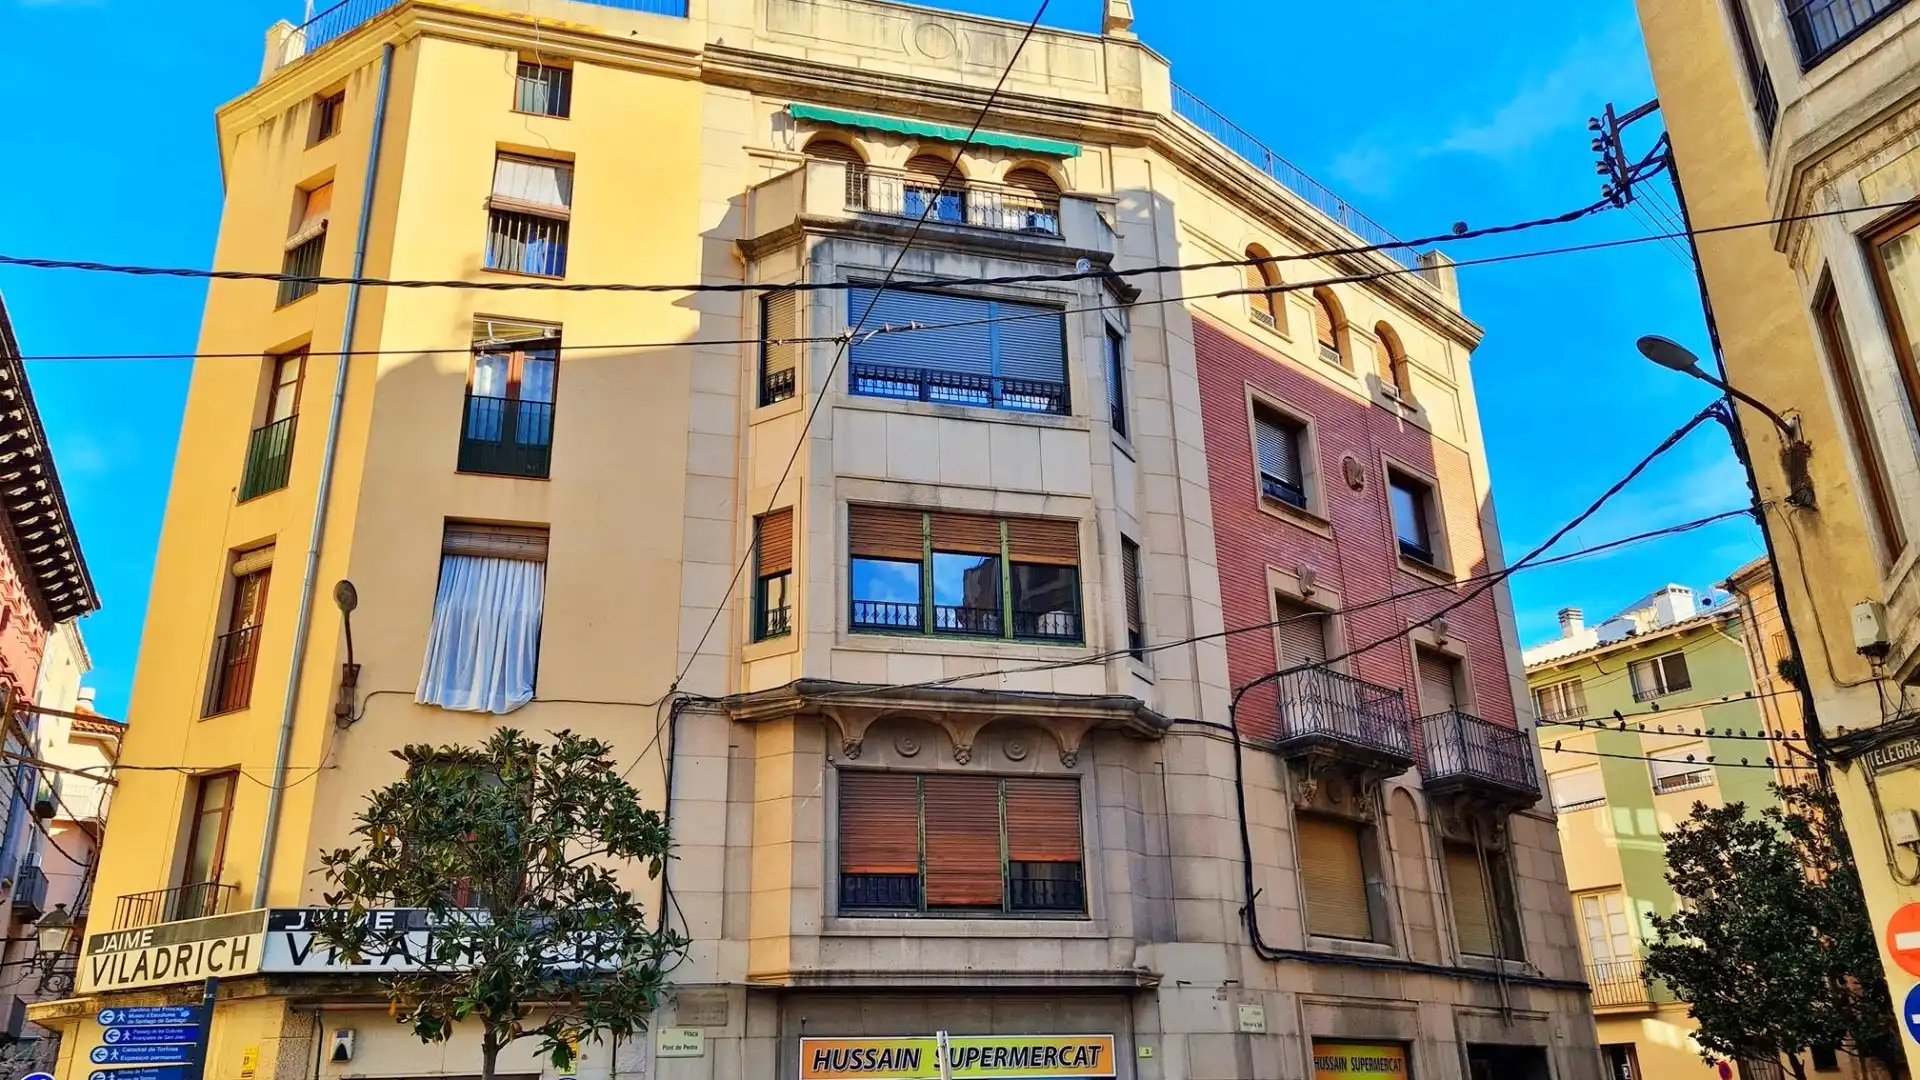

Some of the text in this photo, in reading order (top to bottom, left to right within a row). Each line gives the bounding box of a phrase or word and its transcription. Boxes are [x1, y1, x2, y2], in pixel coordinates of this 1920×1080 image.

[95, 929, 154, 953] JAIME
[93, 936, 250, 987] VILADRICH
[812, 1047, 922, 1072] HUSSAIN
[1314, 1056, 1402, 1072] HUSSAIN SUPERMERCAT
